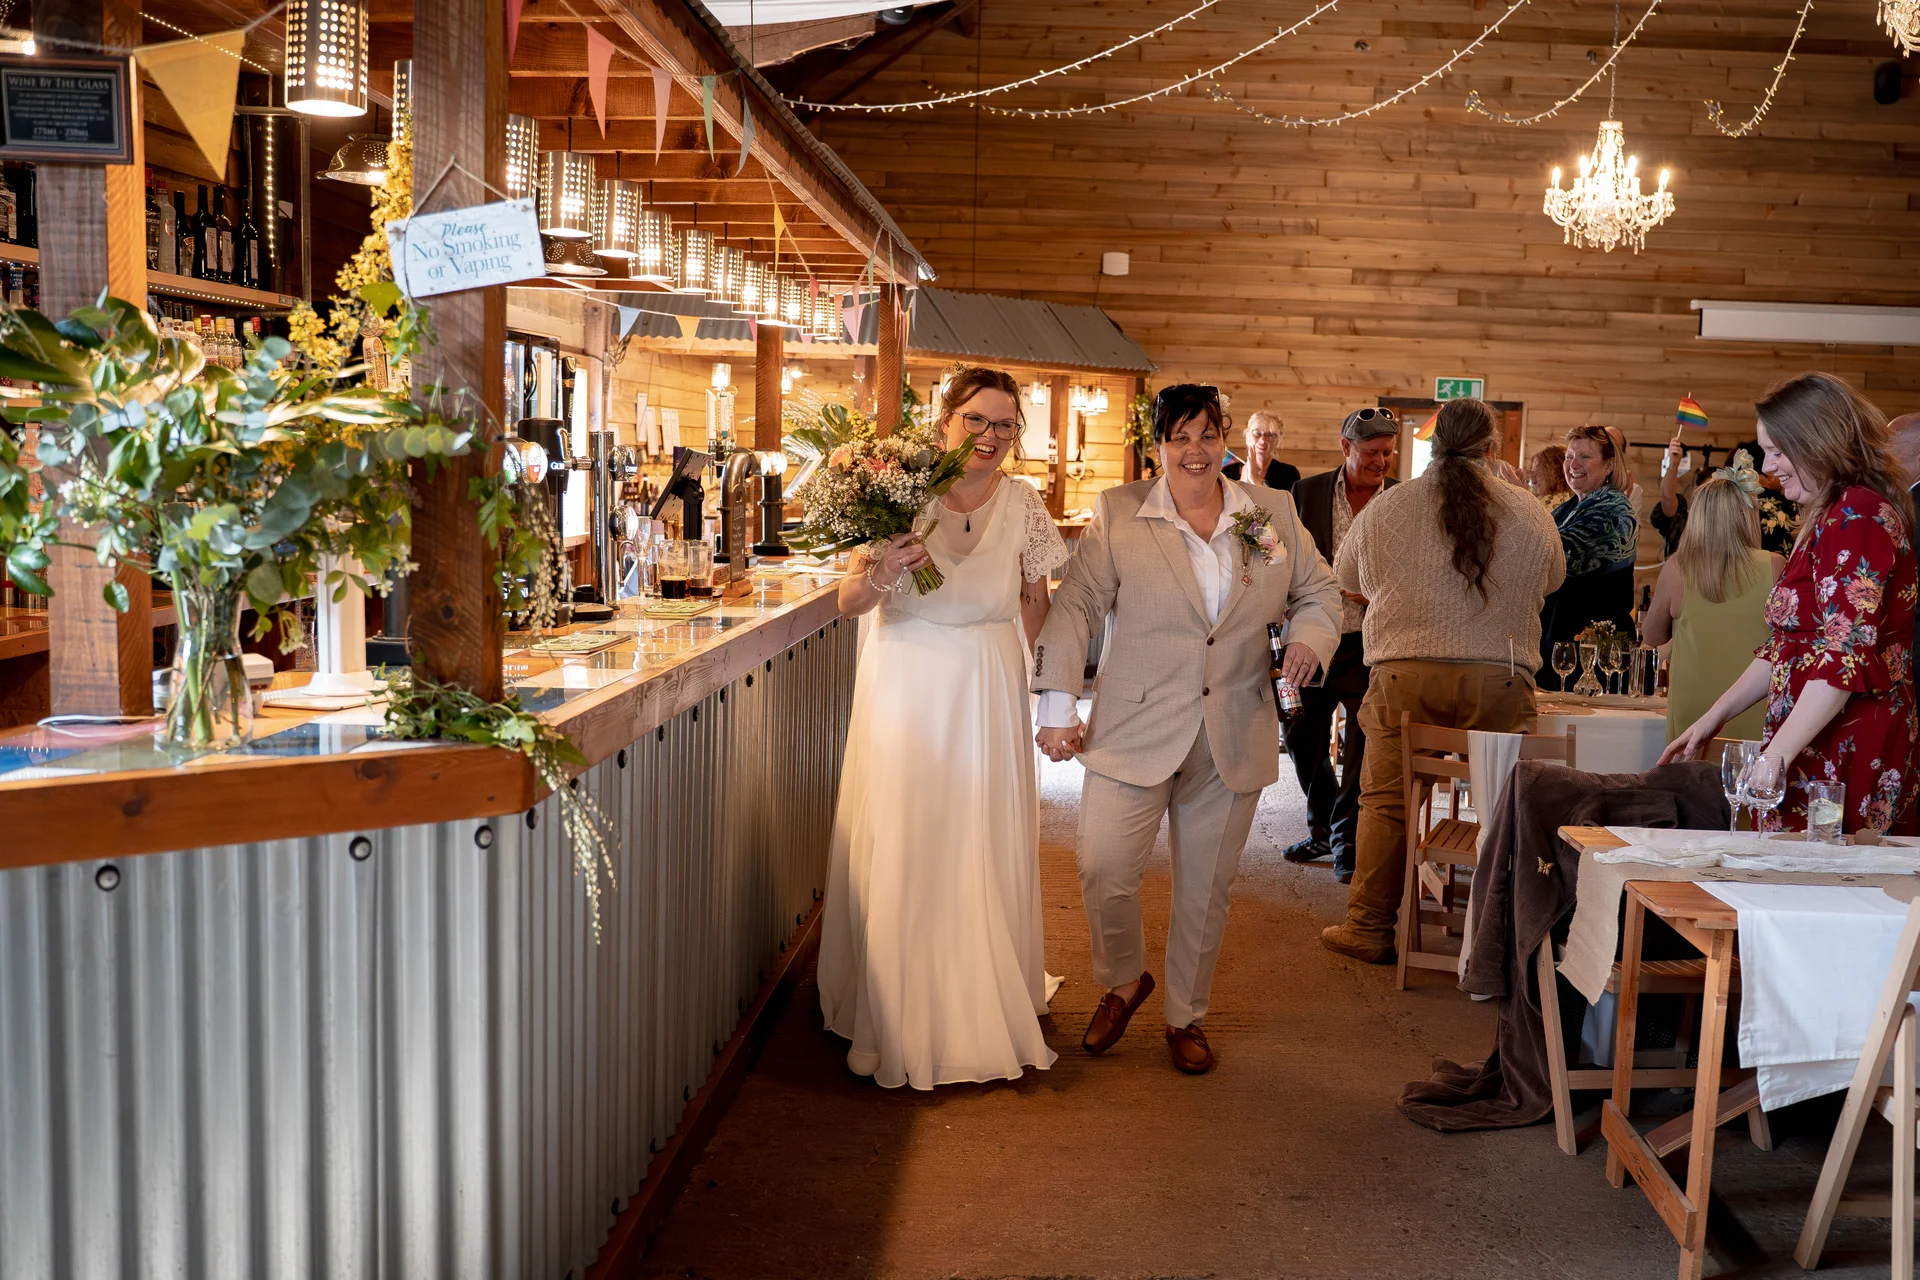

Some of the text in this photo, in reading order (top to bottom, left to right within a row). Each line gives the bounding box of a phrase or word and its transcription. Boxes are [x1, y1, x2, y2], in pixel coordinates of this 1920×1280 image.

[441, 222, 488, 239] Please
[412, 231, 522, 262] No Smoking
[427, 254, 513, 280] or Vaping
